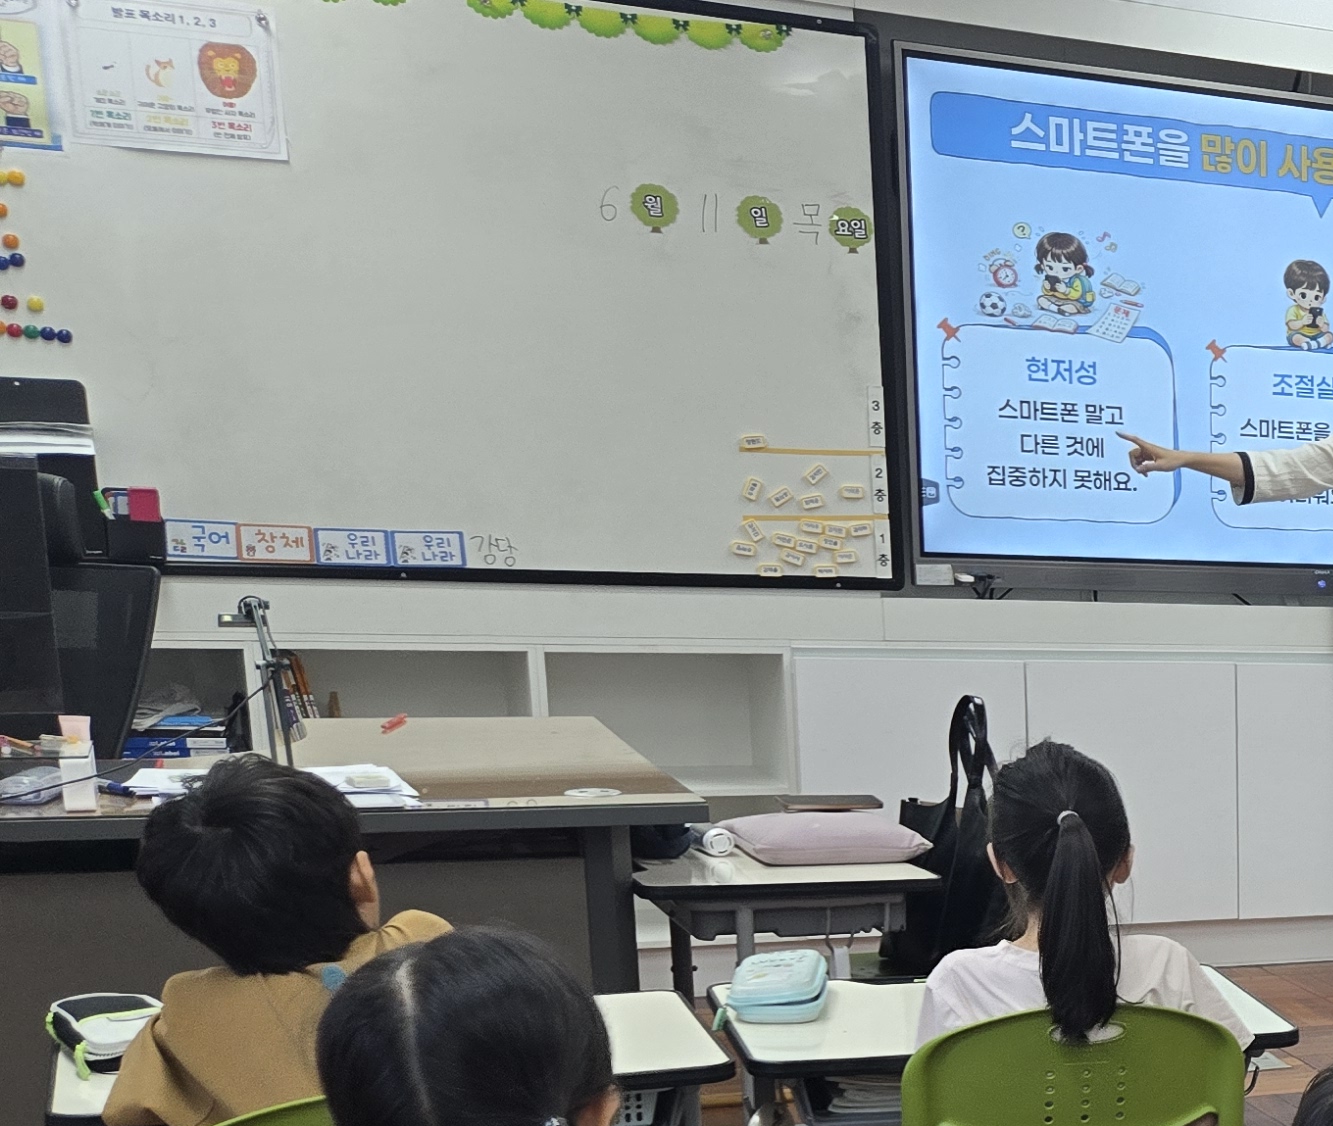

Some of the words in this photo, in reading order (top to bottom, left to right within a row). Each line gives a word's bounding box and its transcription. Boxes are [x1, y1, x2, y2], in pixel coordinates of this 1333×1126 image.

[139, 10, 175, 24] 목소리
[209, 19, 217, 28] 3
[1010, 112, 1191, 169] 스마트폰을
[1201, 133, 1268, 178] 많이
[600, 185, 619, 221] 6
[643, 195, 663, 217] 월
[750, 206, 769, 228] 일
[793, 203, 822, 245] 목
[835, 219, 868, 239] 요일
[1025, 356, 1097, 386] 현저성
[998, 399, 1079, 423] 스마트폰
[1085, 404, 1124, 426] 말고
[1240, 418, 1331, 441] 스마트폰을
[1020, 434, 1059, 456] 다른
[1066, 436, 1105, 458] 것에
[986, 465, 1067, 490] 집중하지
[1073, 470, 1138, 492] 못해요.
[191, 524, 231, 552] 국어
[255, 528, 305, 554] 창체
[347, 533, 375, 549] 우리
[423, 534, 451, 549] 우리
[469, 534, 519, 567] 강당
[345, 549, 381, 562] 나라
[421, 550, 456, 563] 나라
